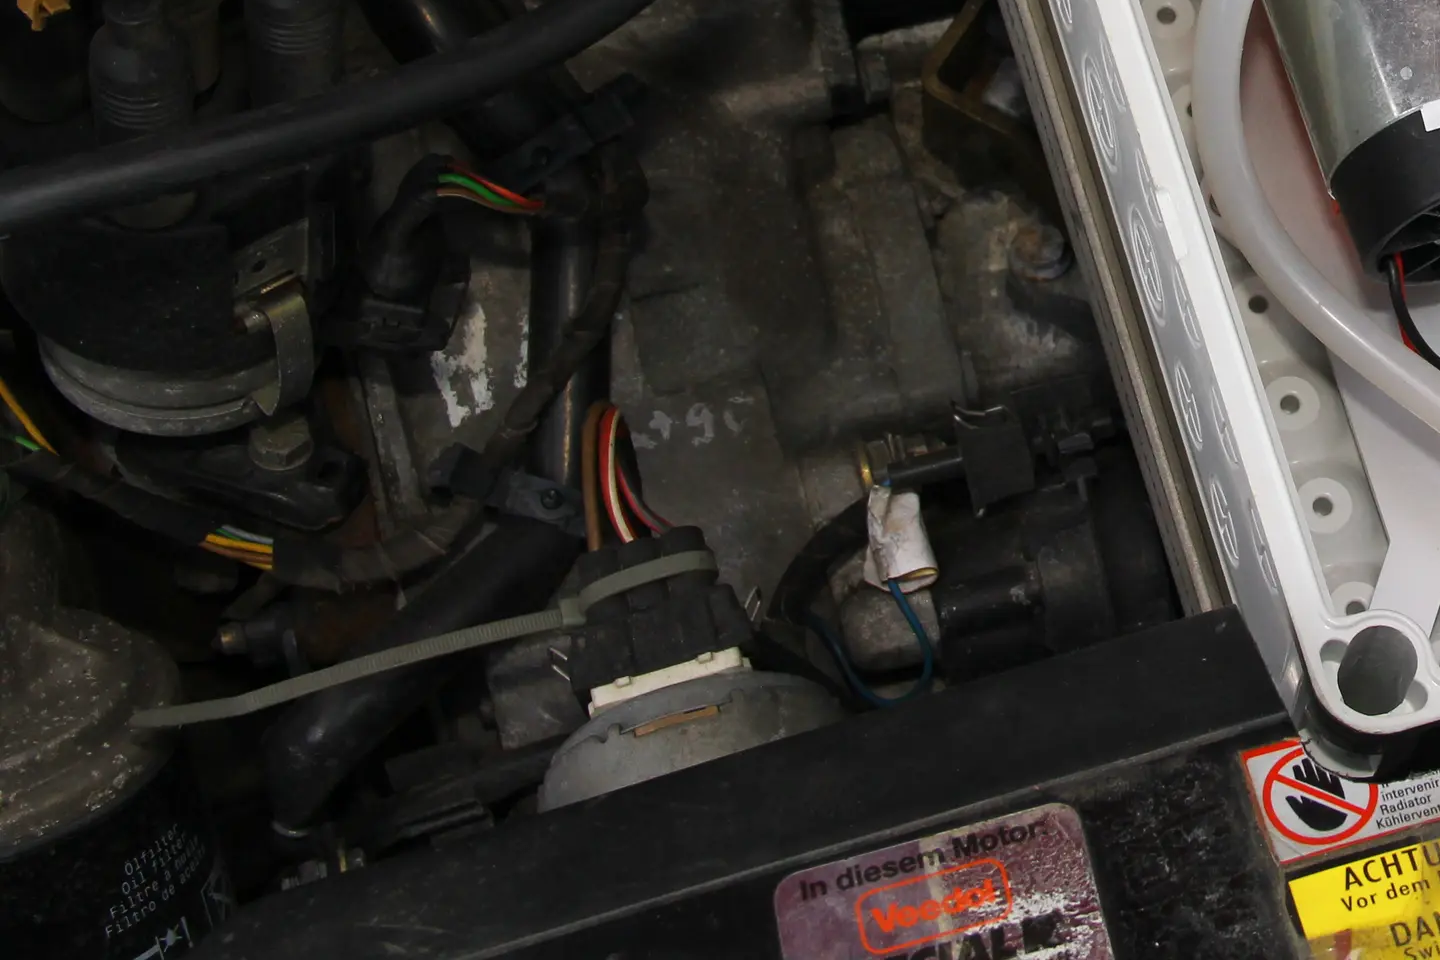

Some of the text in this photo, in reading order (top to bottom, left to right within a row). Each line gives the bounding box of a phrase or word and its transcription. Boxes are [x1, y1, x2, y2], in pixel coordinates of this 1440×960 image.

[1379, 794, 1432, 816] Radiator
[121, 830, 186, 894] Oil filter
[124, 823, 178, 876] Ölfilter
[800, 879, 827, 901] In
[836, 847, 945, 891] diesem
[105, 900, 156, 938] Filtro
[162, 884, 176, 900] de
[109, 880, 159, 919] Filtre
[870, 878, 1000, 933] Veedol
[1341, 892, 1378, 912] Vor
[1386, 878, 1431, 900] dem
